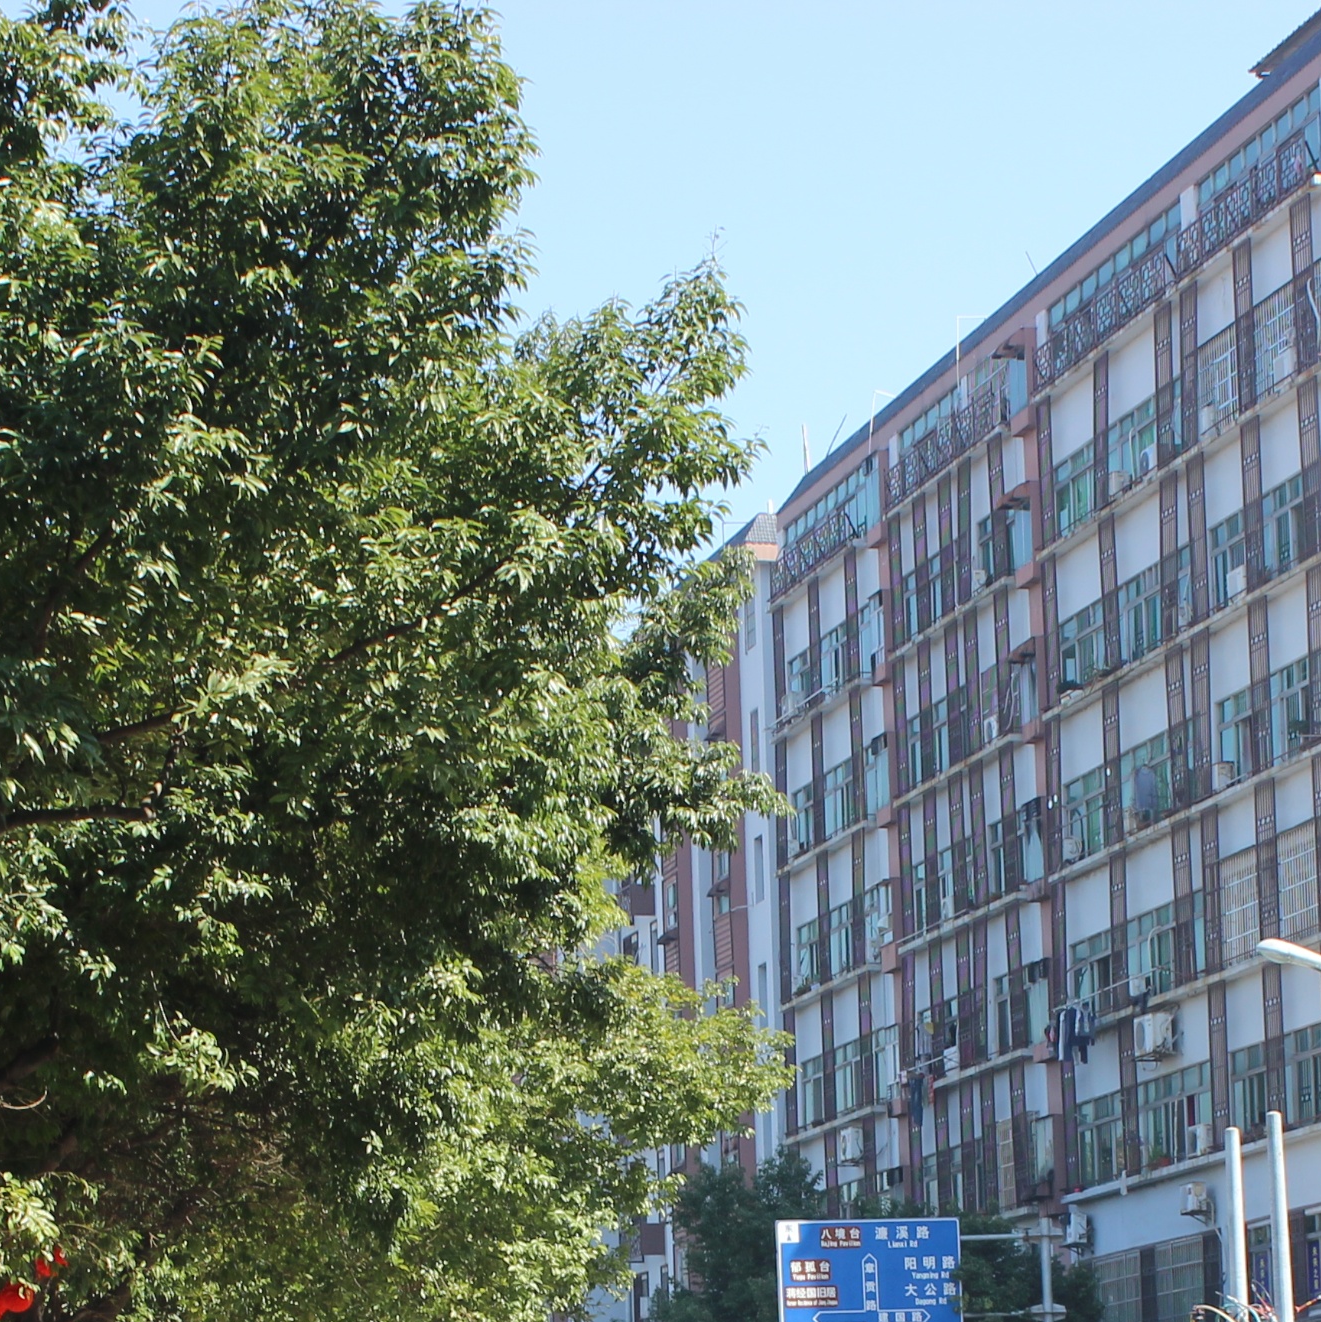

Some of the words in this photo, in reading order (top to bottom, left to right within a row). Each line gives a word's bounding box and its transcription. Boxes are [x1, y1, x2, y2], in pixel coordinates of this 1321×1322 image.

[821, 1227, 861, 1240] 八境台
[875, 1226, 930, 1241] 濂溪路
[909, 1240, 918, 1248] Rd
[790, 1261, 830, 1273] 郁孤台
[904, 1255, 955, 1270] 阳明路
[940, 1271, 949, 1279] Rd
[785, 1286, 836, 1299] 蒋经国旧居
[864, 1262, 877, 1311] 章贡路
[904, 1282, 956, 1297] 大公路
[878, 1311, 923, 1322] 建国路
